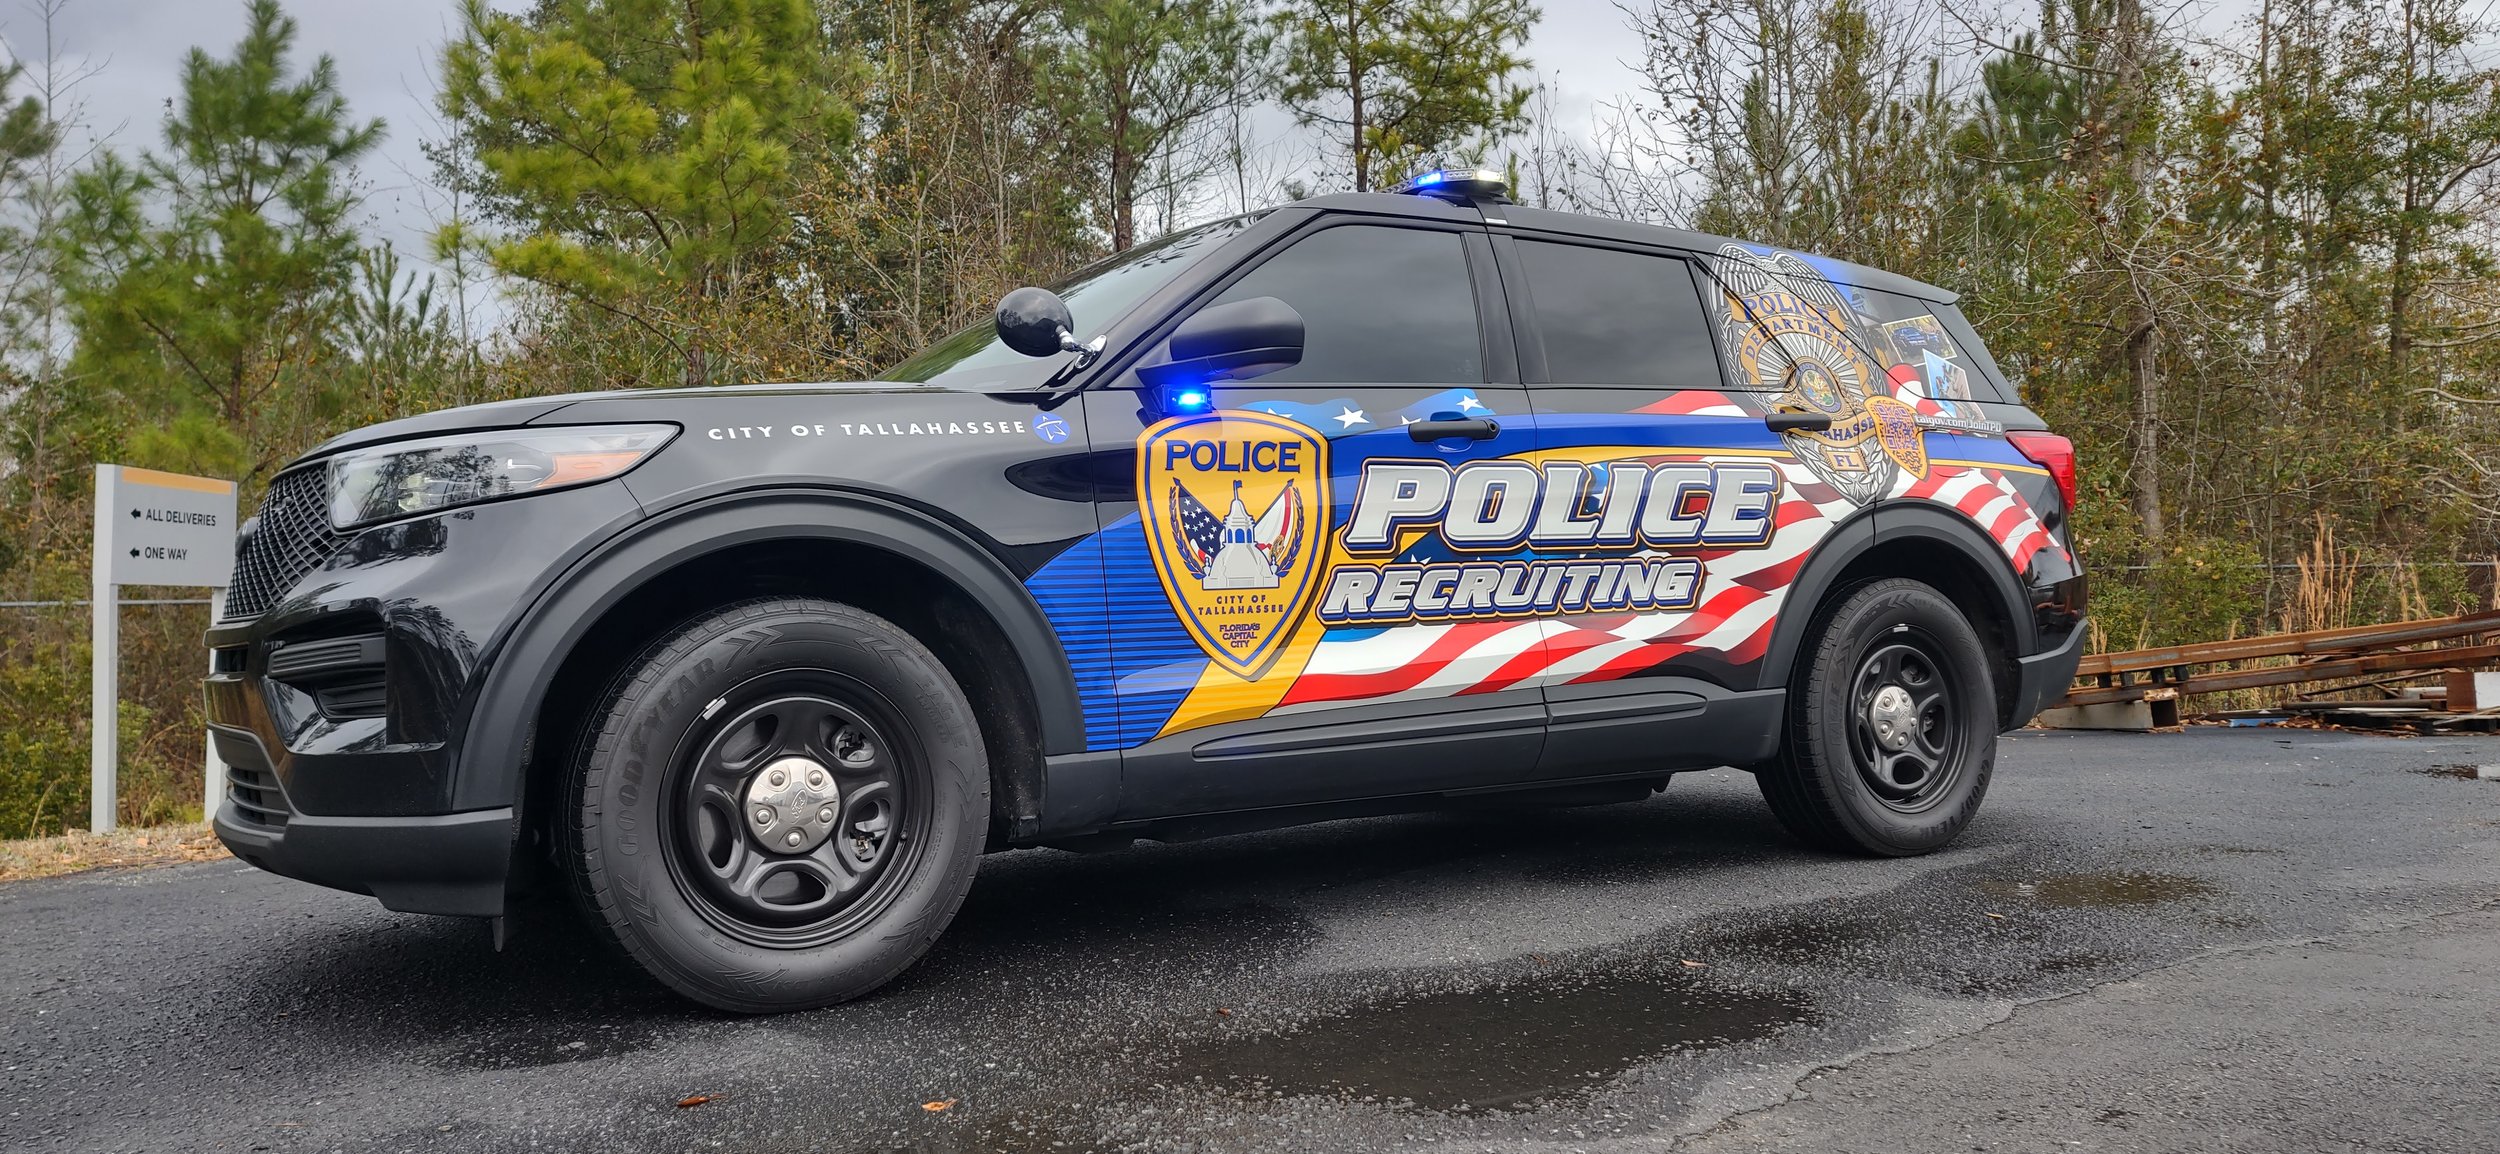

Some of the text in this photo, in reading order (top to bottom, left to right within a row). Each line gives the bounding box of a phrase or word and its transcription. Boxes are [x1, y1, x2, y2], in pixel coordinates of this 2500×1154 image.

[1744, 292, 1830, 328] POLICE
[1745, 318, 1861, 364] DEPARTMENT
[708, 420, 1027, 441] CITY OF TALLAHASSEE
[1165, 439, 1302, 474] POLICE
[1833, 454, 1860, 468] FL
[1343, 461, 1782, 548] POLICE
[145, 508, 216, 527] ALL DELIVERIES
[144, 546, 188, 560] ONE WAY
[1216, 594, 1266, 604] CITY OF
[1319, 560, 1701, 618] RECRUITING
[1198, 604, 1284, 616] TALLAHASSEE
[1222, 631, 1257, 640] CAPITAL
[1230, 640, 1250, 648] CITY
[616, 657, 716, 856] GOODYEAR
